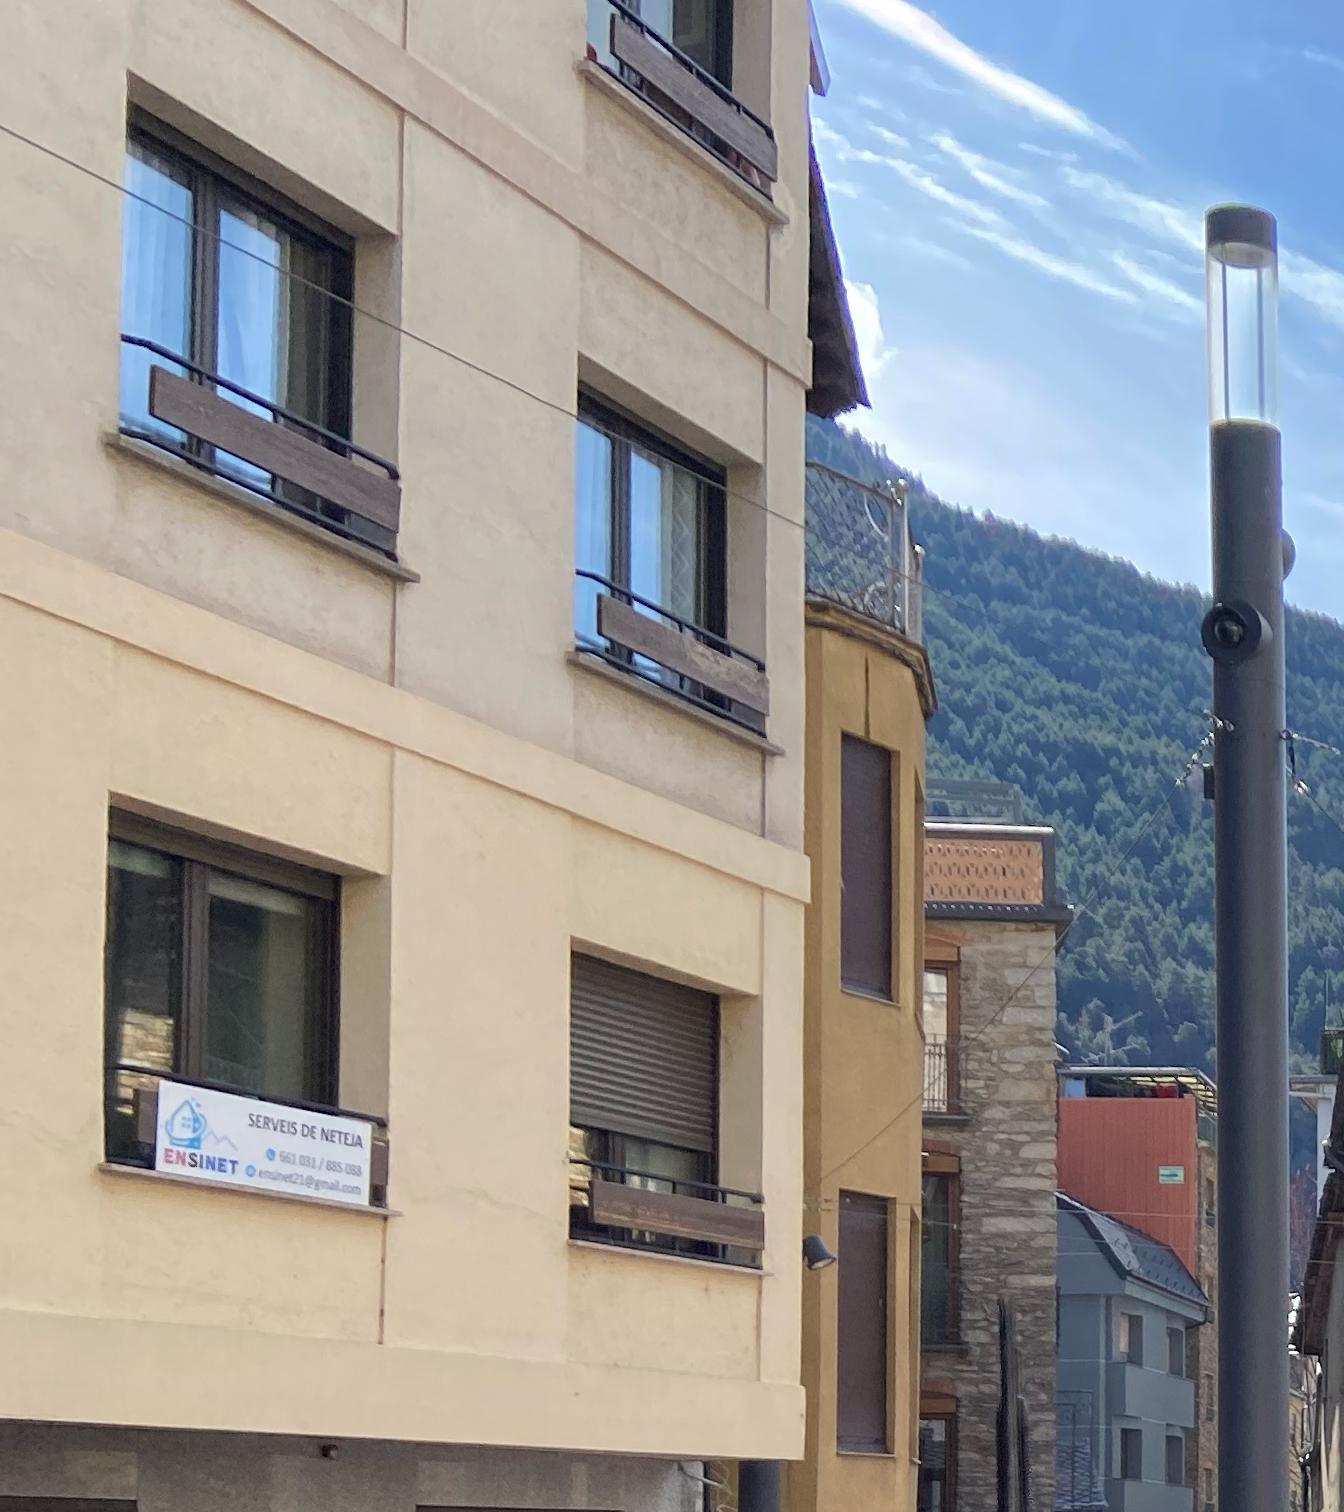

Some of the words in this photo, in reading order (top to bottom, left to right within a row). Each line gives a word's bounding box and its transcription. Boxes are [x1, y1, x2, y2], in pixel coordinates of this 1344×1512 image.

[248, 1113, 298, 1136] SERVEIS
[301, 1123, 317, 1140] DE
[320, 1127, 363, 1148] NETEJA
[163, 1148, 238, 1175] ENSINET
